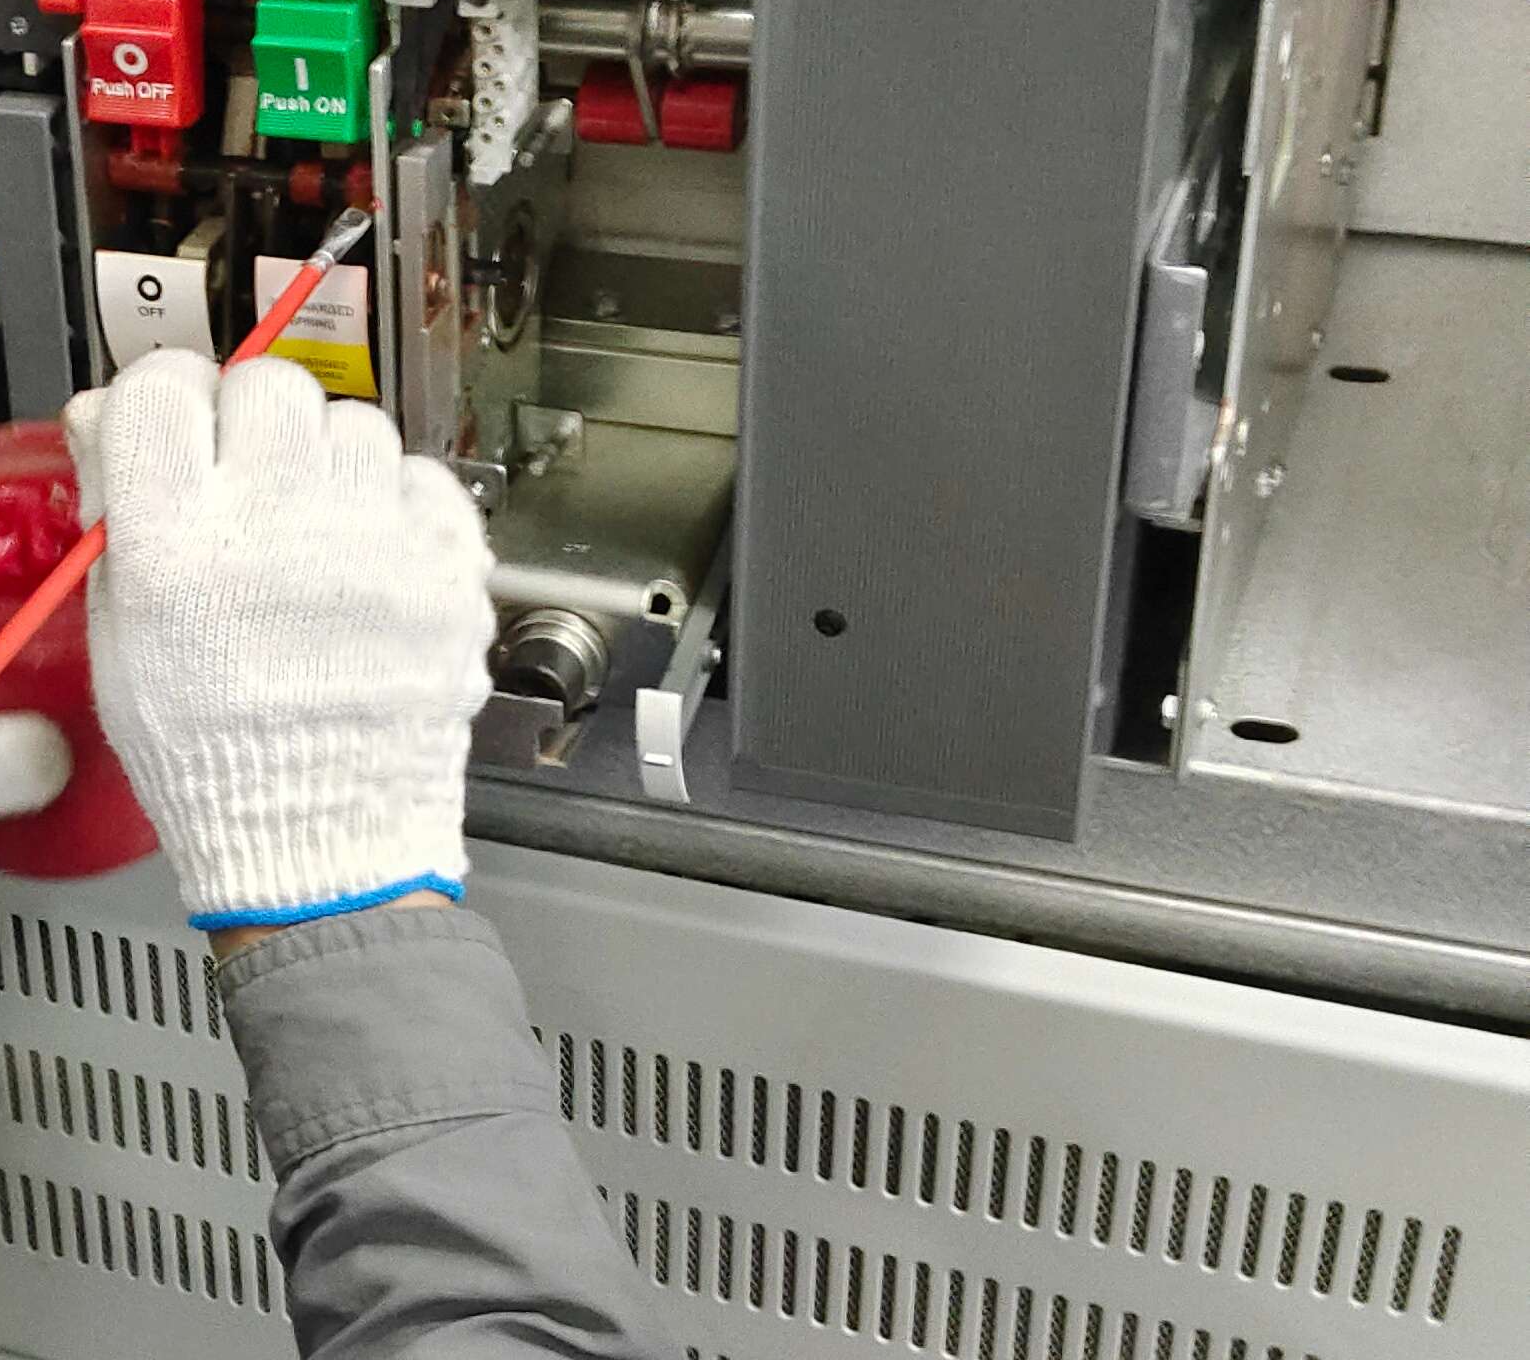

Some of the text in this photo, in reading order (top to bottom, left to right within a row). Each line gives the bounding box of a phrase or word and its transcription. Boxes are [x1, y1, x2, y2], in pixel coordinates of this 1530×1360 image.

[91, 77, 174, 101] Push OFF
[261, 93, 347, 115] Push ON
[137, 305, 167, 319] OFF
